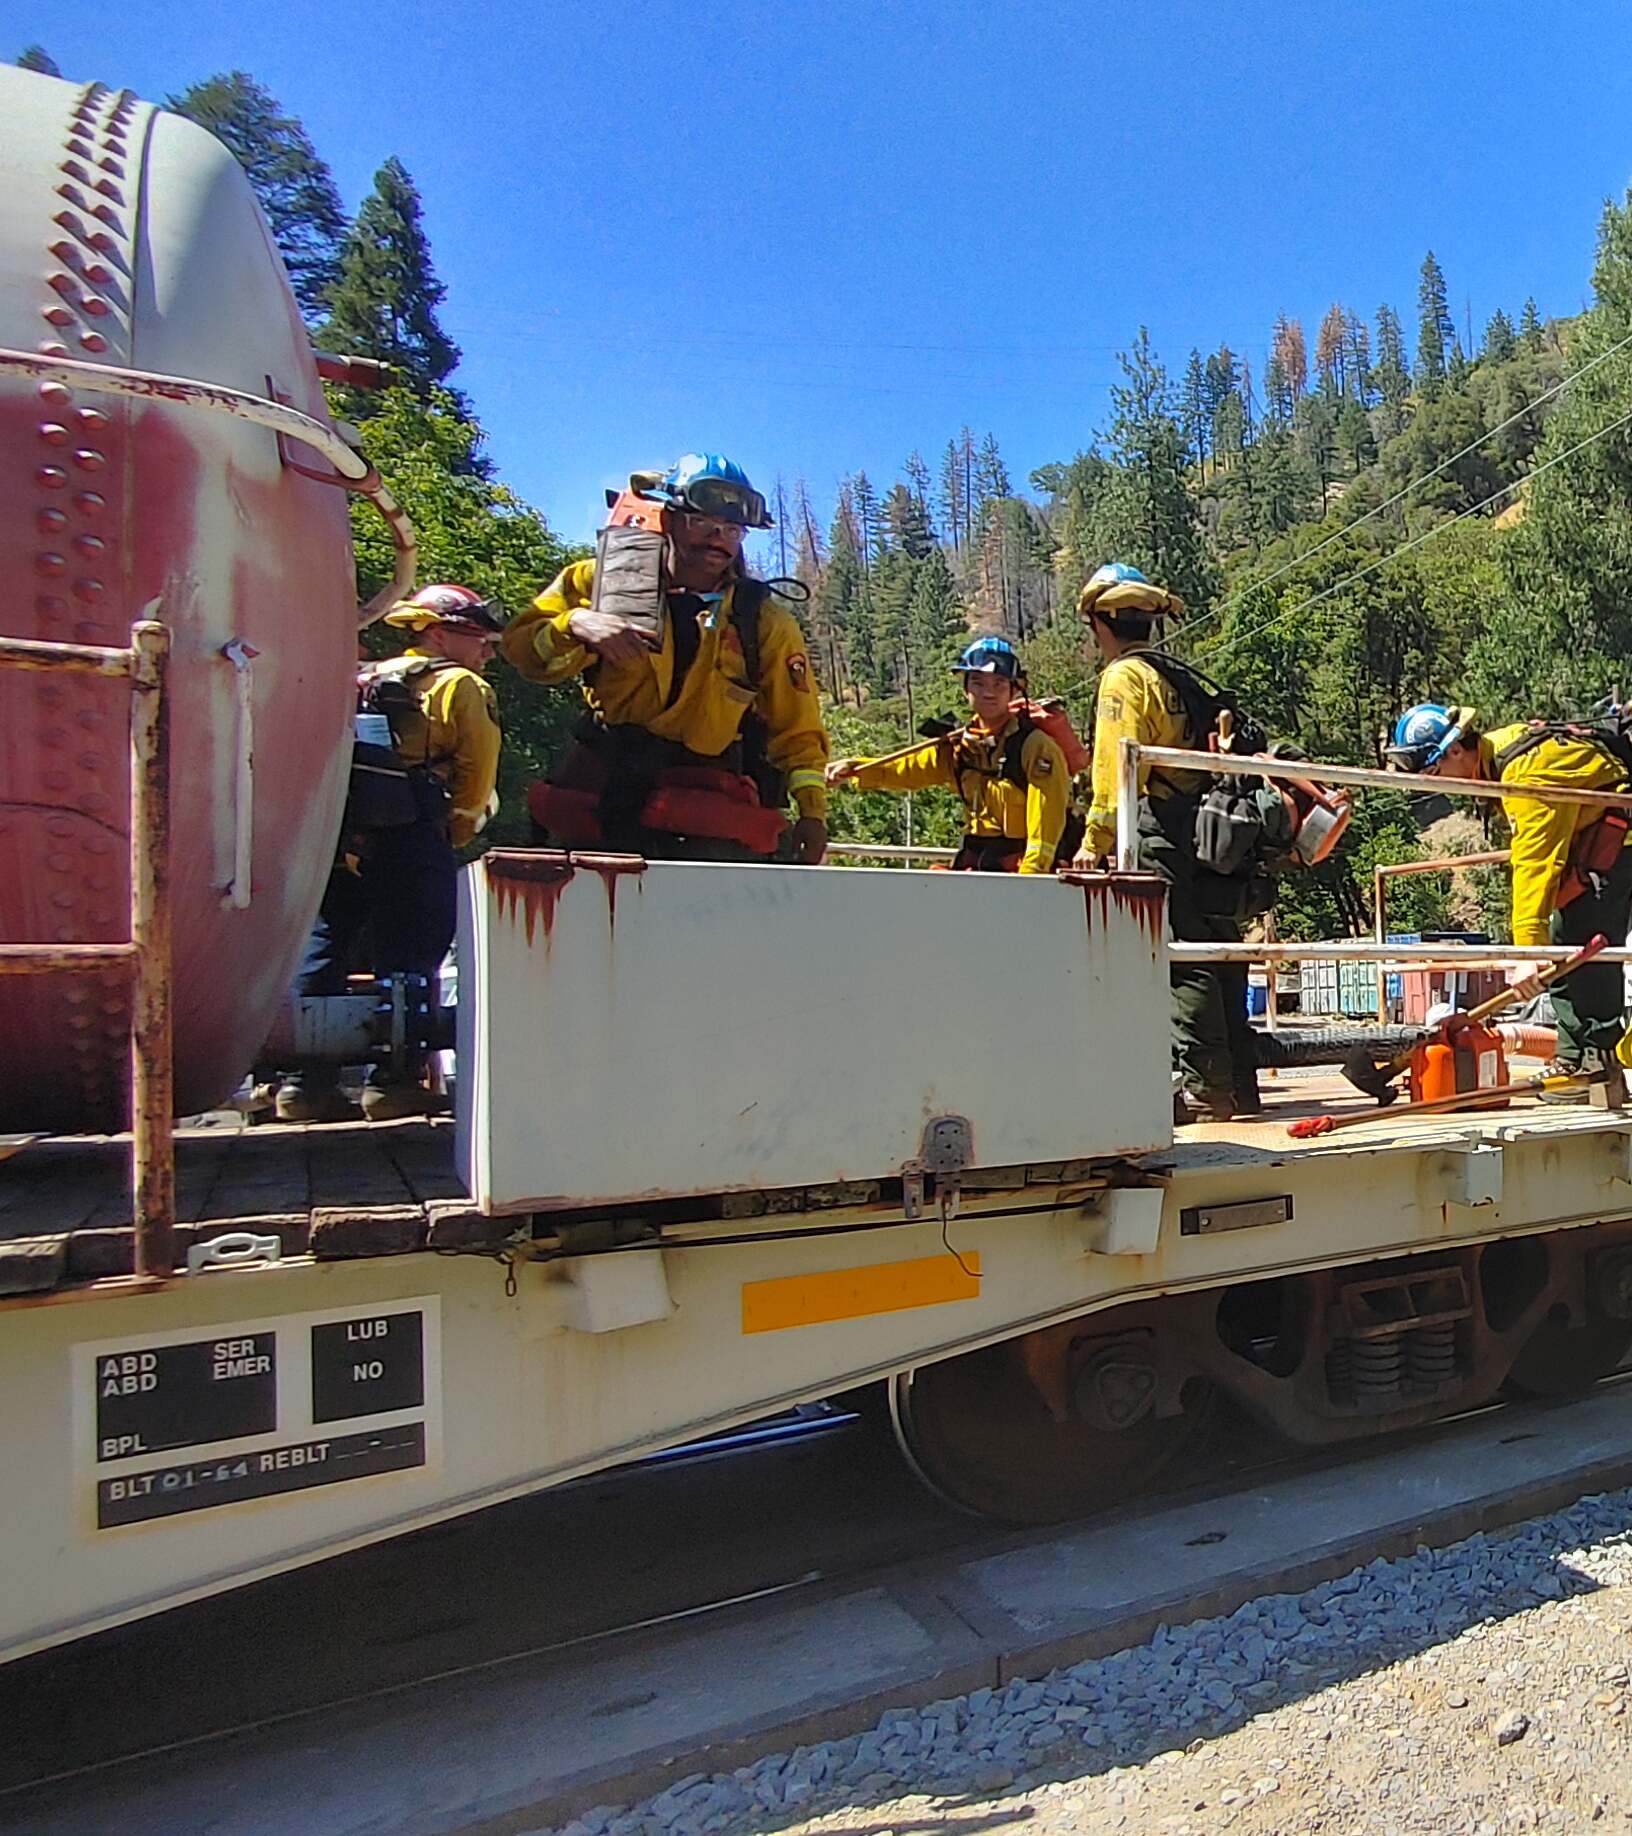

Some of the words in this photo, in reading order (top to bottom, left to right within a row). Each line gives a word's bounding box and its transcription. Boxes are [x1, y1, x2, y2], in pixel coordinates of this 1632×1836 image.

[347, 1320, 389, 1341] LUB
[213, 1339, 255, 1361] SER
[102, 1353, 158, 1378] ABD
[213, 1355, 271, 1381] EMER
[353, 1361, 384, 1382] NO
[102, 1373, 158, 1397] ABD
[102, 1434, 149, 1458] BPL
[110, 1475, 155, 1501] BLT
[259, 1443, 331, 1473] REBLT
